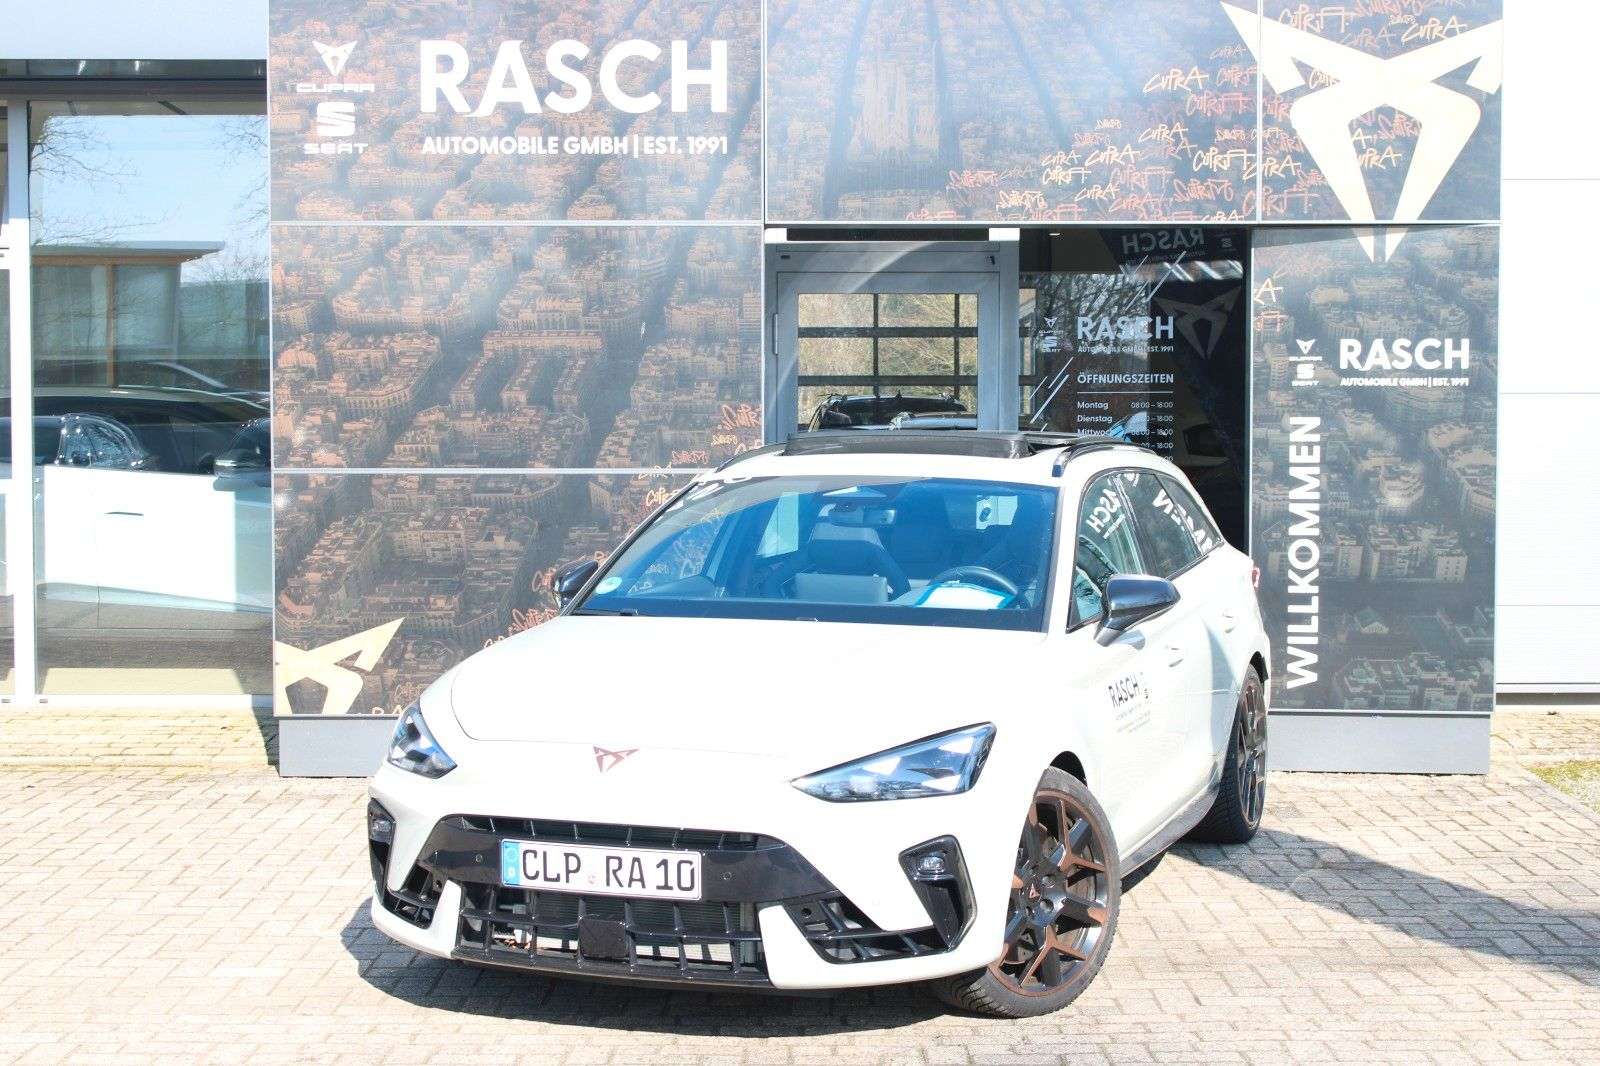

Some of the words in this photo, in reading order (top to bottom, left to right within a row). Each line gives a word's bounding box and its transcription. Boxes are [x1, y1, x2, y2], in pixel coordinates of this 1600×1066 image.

[420, 38, 729, 118] RASCH
[1143, 66, 1209, 93] CUPRA
[1138, 122, 1188, 144] CUPRA
[304, 142, 369, 155] SEAT
[422, 136, 559, 156] AUTOMOBILE
[563, 136, 629, 156] GMBH
[643, 136, 683, 156] EST.
[687, 136, 728, 155] 1991
[1085, 144, 1140, 167] CUPRA
[1077, 316, 1174, 341] RASCH
[1339, 338, 1470, 371] RASCH
[1077, 372, 1174, 384] ÖFFNUNGSZEITEN
[1340, 377, 1398, 387] AUTOMOBILE
[1077, 401, 1109, 411] Montag
[1077, 415, 1112, 424] Dienstag
[1286, 416, 1321, 690] WILLKOMMEN
[1108, 673, 1142, 709] RASCH
[522, 849, 582, 884] CLP
[605, 855, 646, 889] RA
[656, 858, 695, 892] 10
